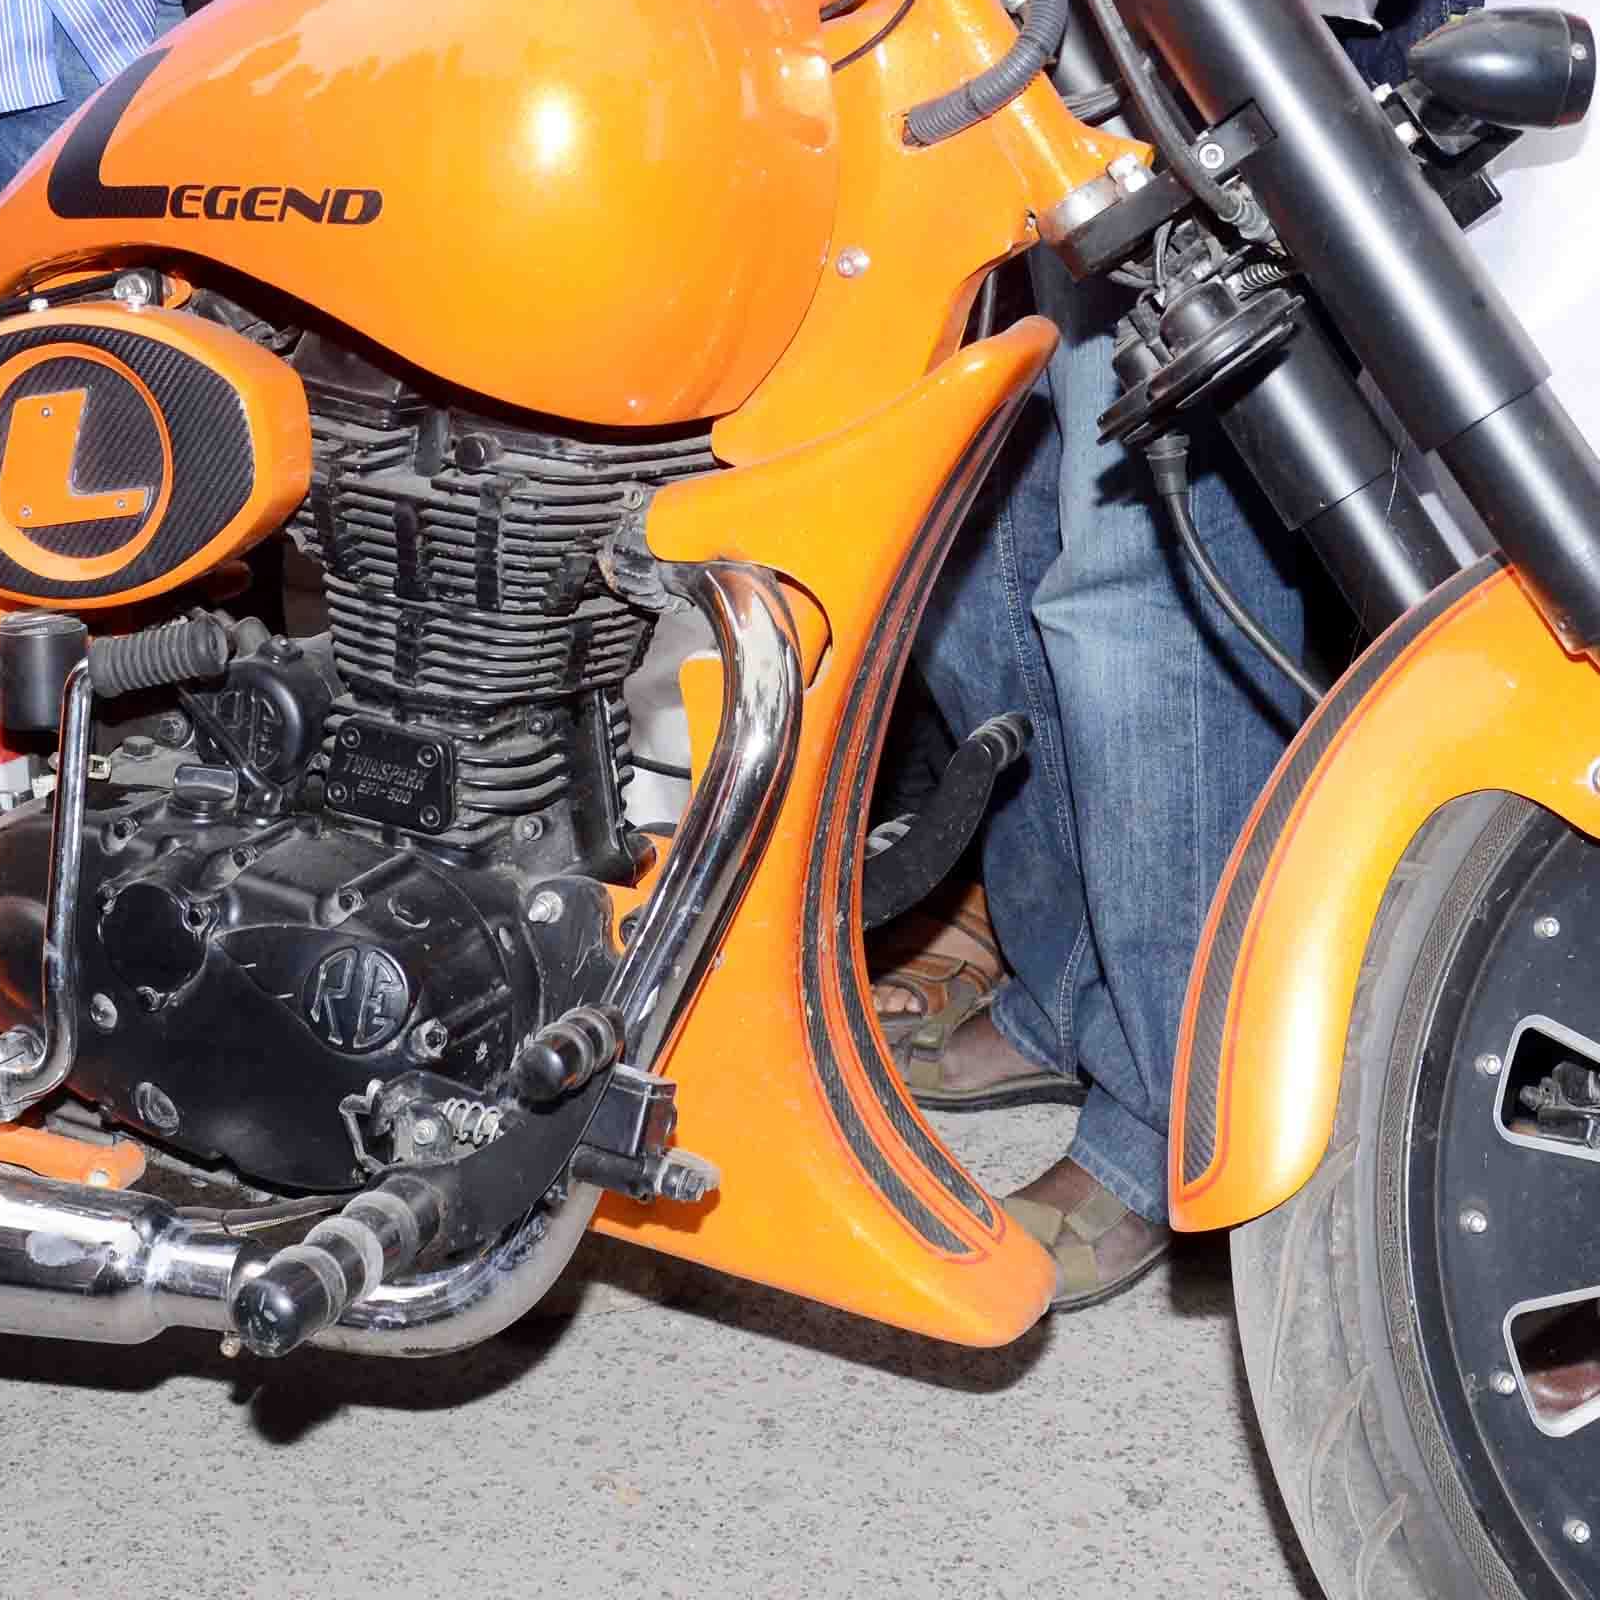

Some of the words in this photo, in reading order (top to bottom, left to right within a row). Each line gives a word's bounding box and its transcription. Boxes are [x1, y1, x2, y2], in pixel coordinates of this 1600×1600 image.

[47, 45, 384, 225] LEGEND
[343, 751, 432, 792] TWINSPARK
[356, 779, 414, 805] EFI-500
[311, 946, 409, 1050] RE
